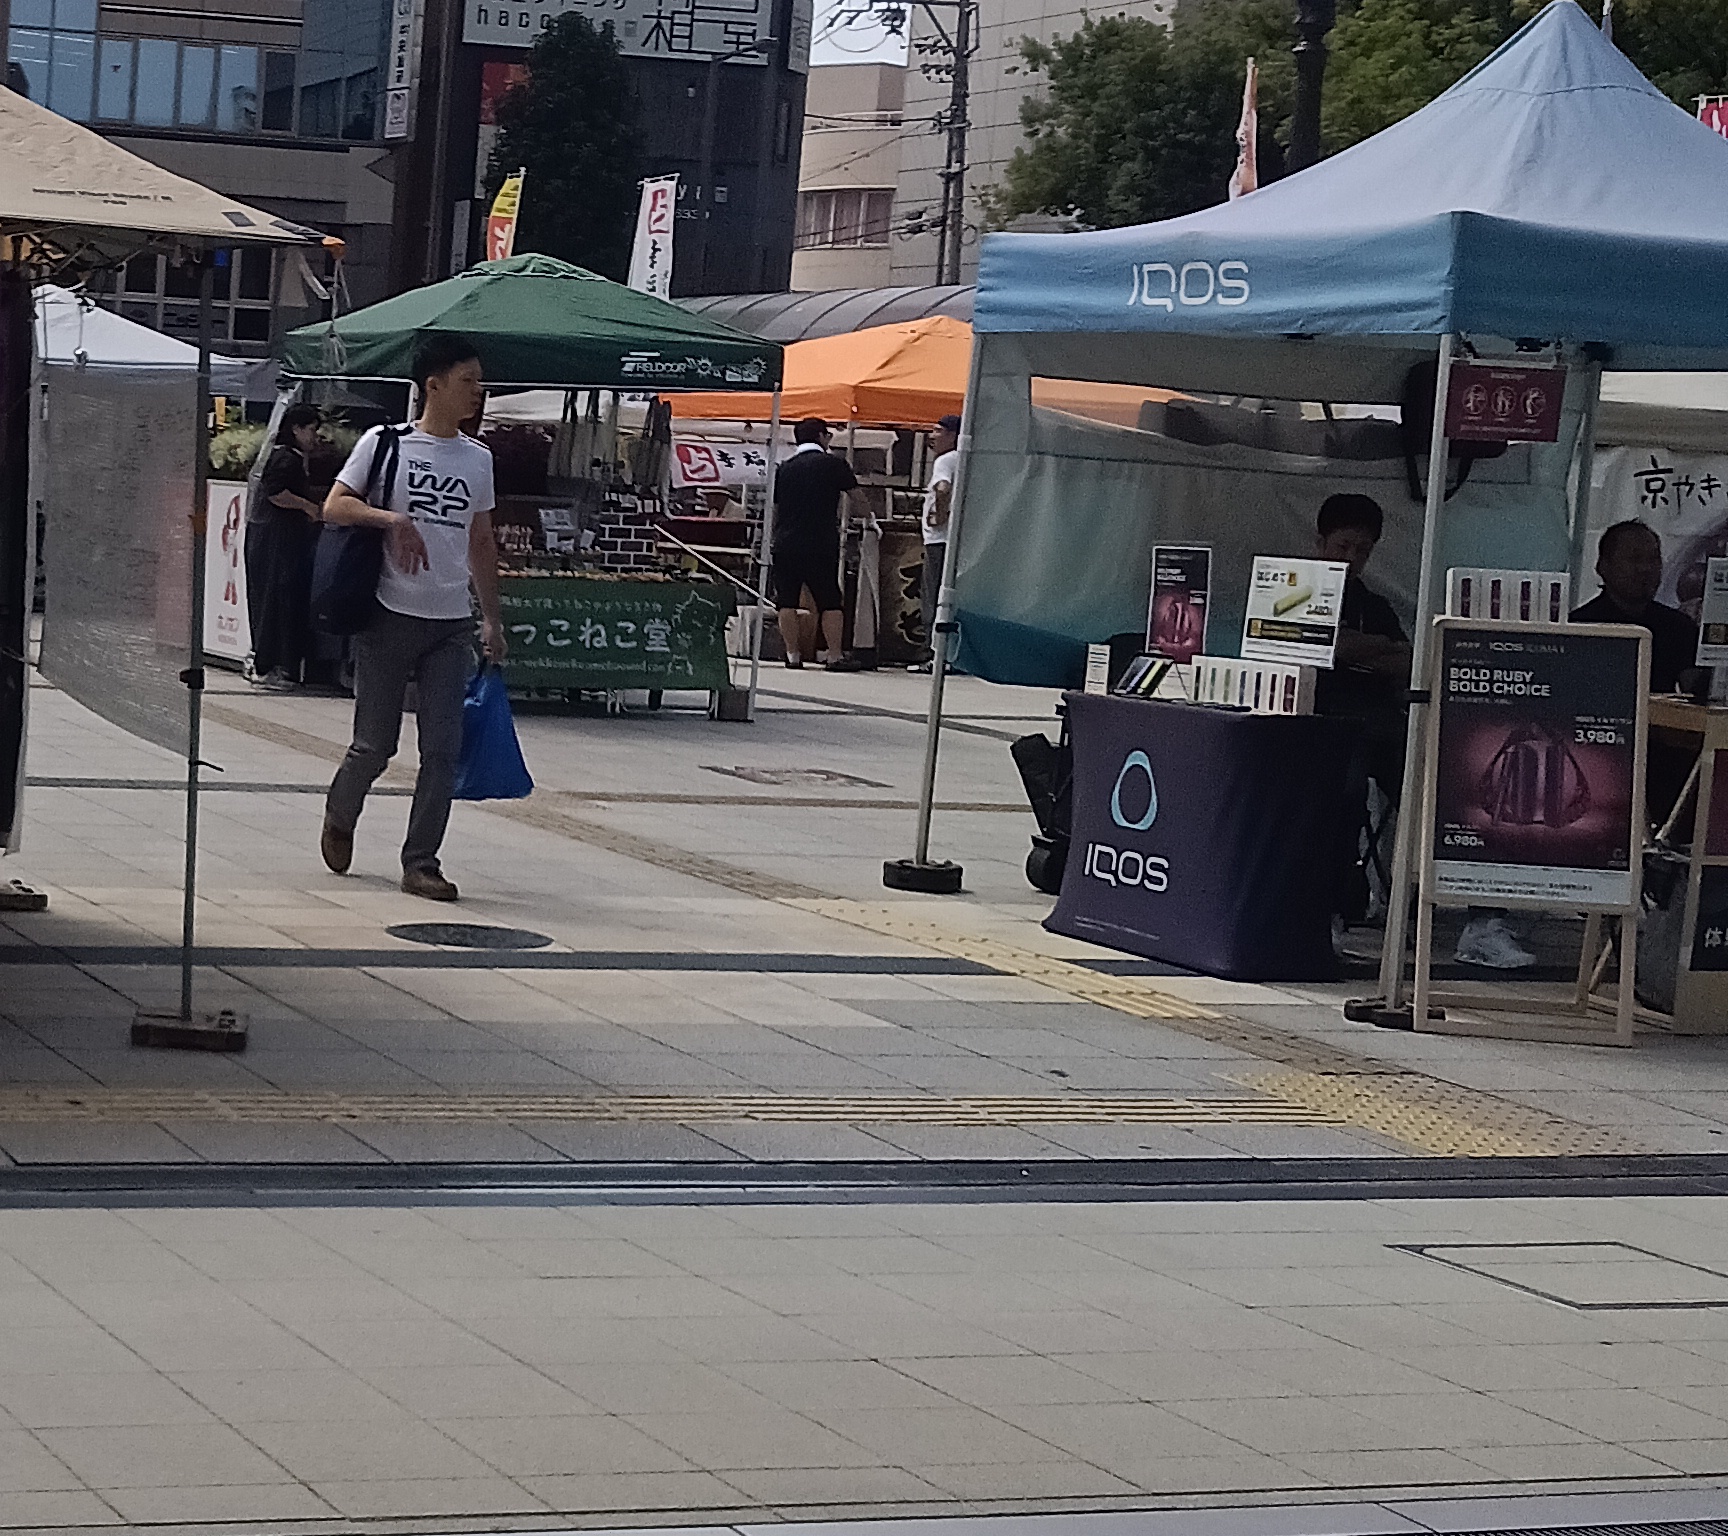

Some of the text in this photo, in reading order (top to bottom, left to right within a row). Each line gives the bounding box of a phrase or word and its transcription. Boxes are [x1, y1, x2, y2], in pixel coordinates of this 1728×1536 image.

[1126, 260, 1251, 312] IQOS
[408, 460, 432, 472] THE
[1633, 454, 1728, 516] 京やき
[1449, 667, 1534, 682] BOLD RUBY
[1449, 680, 1552, 697] BOLD CHOICE
[1083, 840, 1170, 893] IQOS
